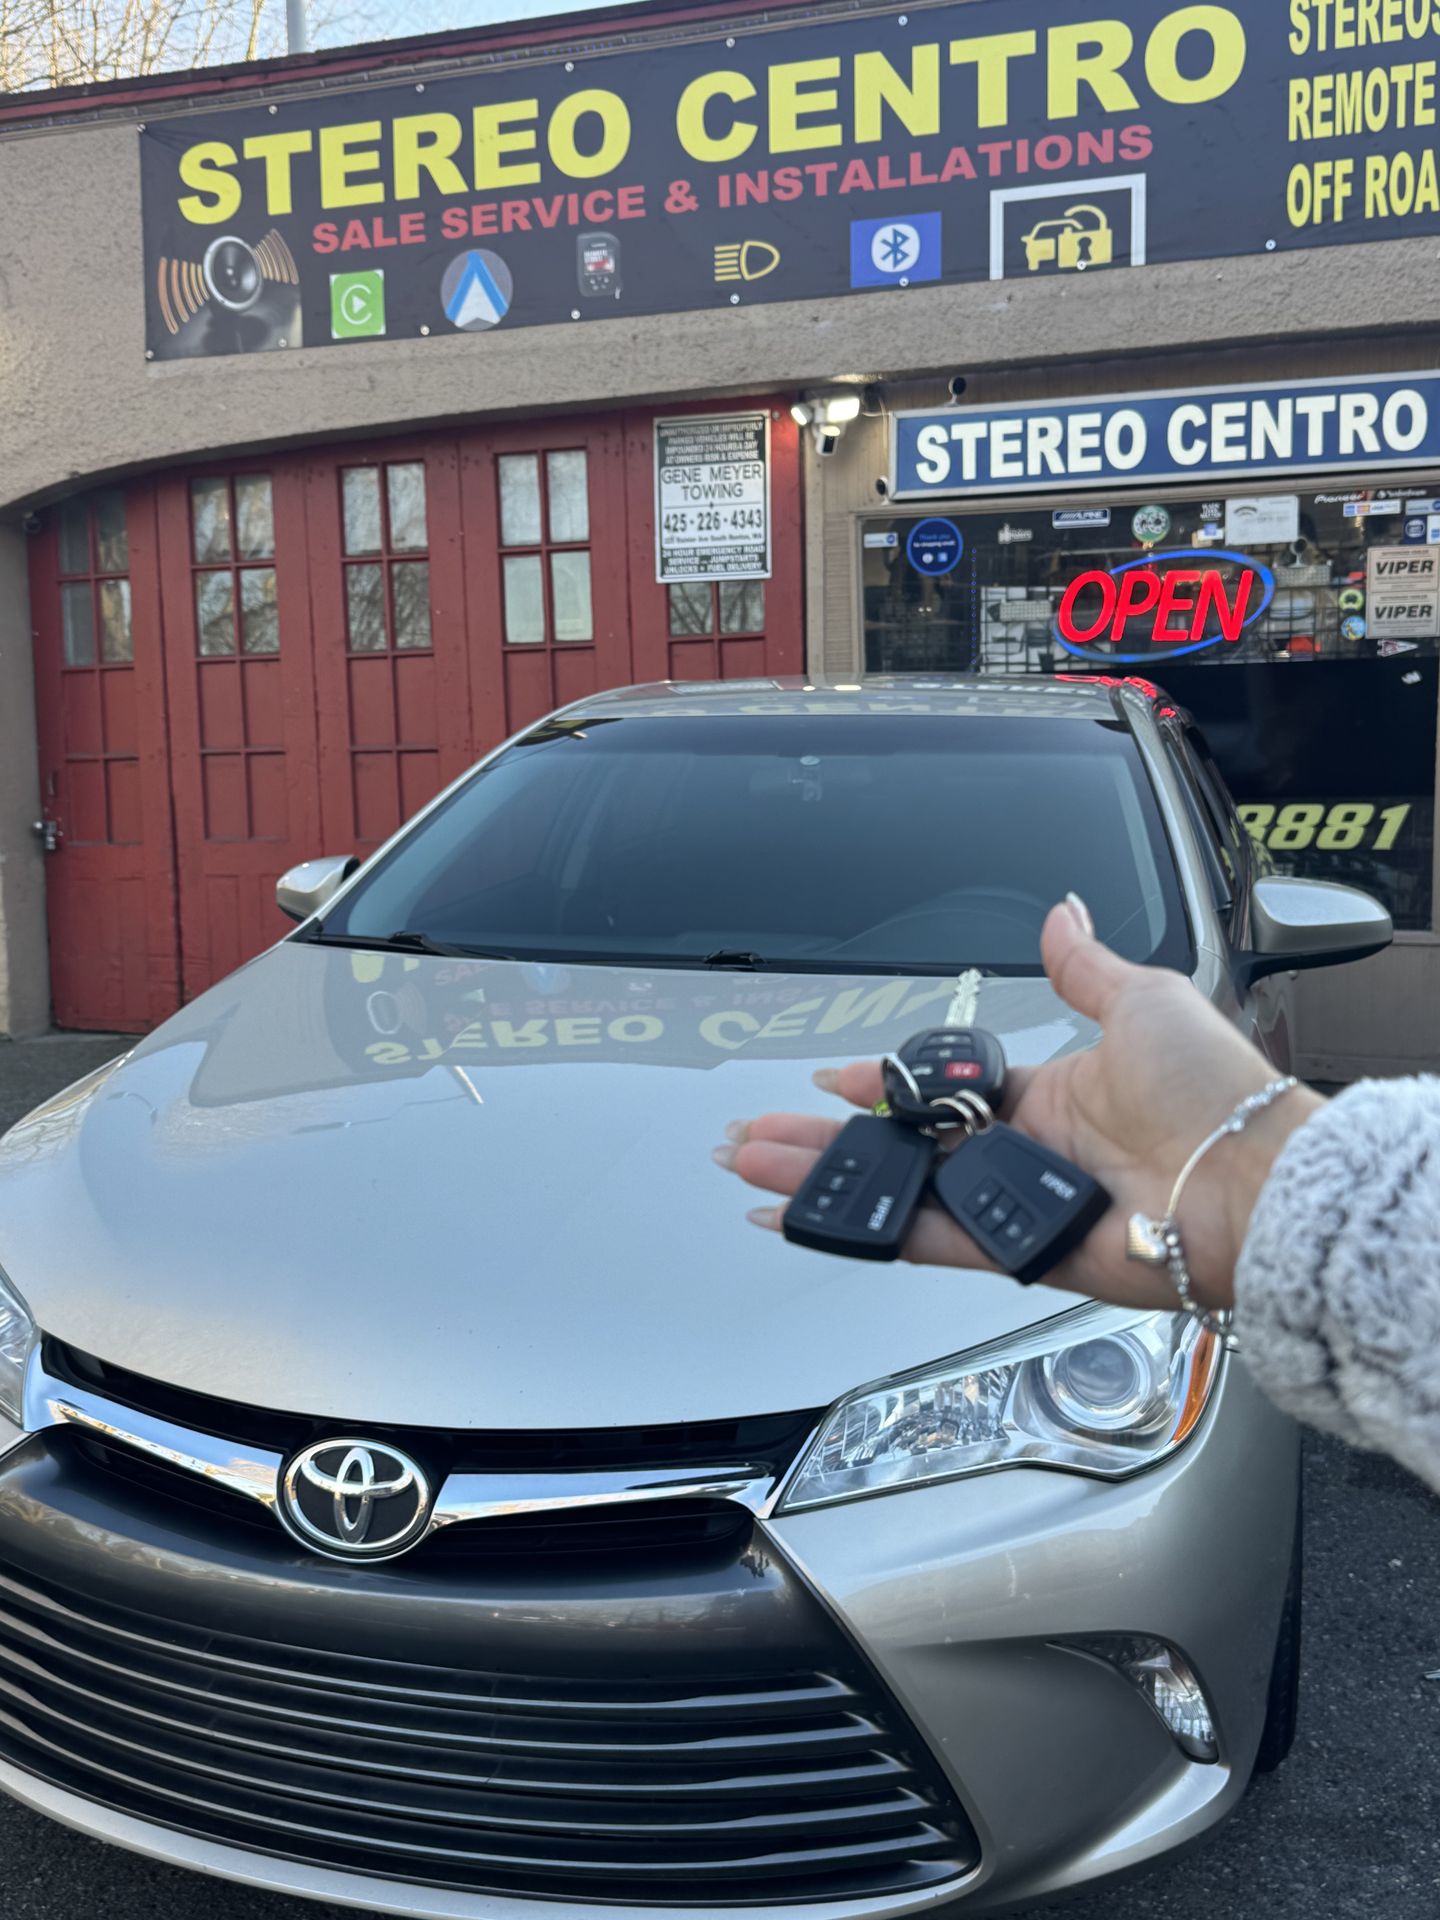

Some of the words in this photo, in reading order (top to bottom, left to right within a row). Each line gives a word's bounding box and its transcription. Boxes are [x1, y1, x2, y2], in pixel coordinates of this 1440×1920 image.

[178, 89, 631, 225] STEREO
[676, 5, 1245, 163] CENTRO
[1288, 60, 1437, 142] REMOTE
[312, 211, 426, 254] SALE
[442, 186, 645, 239] SERVICE
[664, 180, 698, 213] &
[718, 125, 1153, 208] INSTALLATIONS
[1286, 158, 1354, 228] OFF
[915, 409, 1147, 484] STEREO
[1167, 389, 1428, 466] CENTRO
[662, 467, 702, 484] GENE
[709, 465, 762, 481] MEYER
[680, 483, 744, 501] TOWING
[1375, 560, 1434, 575] VIPER
[1058, 570, 1253, 642] OPEN
[1374, 604, 1433, 620] VIPER
